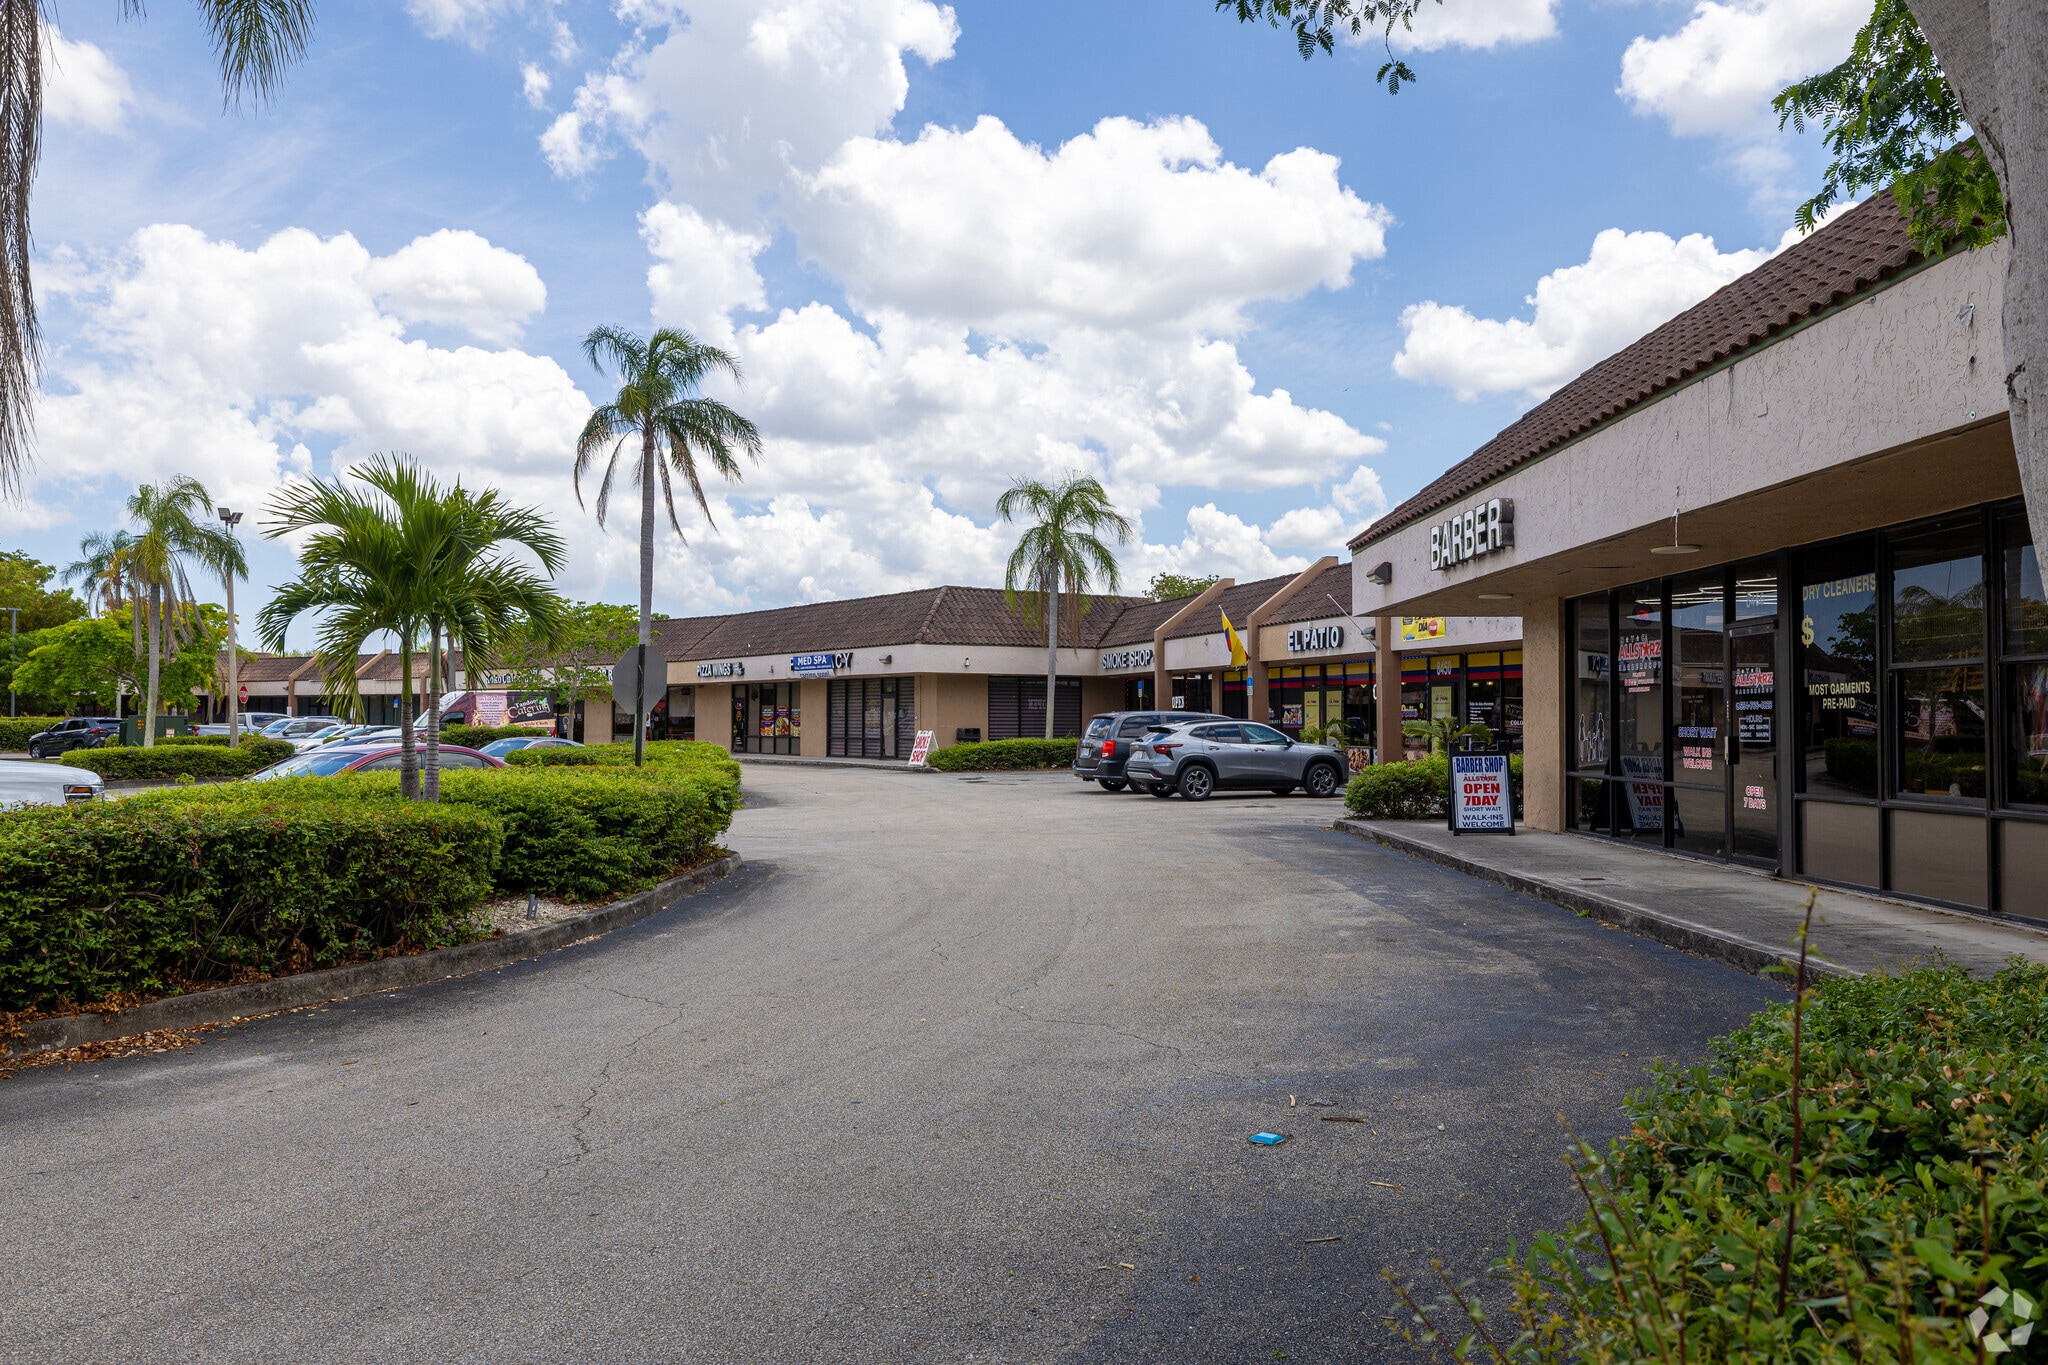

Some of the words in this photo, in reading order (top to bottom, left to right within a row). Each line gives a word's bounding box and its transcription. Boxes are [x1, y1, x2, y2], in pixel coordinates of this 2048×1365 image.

[1430, 498, 1504, 571] BARBER
[1802, 585, 1820, 601] DRY
[1823, 573, 1877, 598] CLEANERS
[1801, 614, 1815, 648] $
[1287, 631, 1301, 652] EL
[1303, 626, 1340, 650] PATIO
[797, 656, 812, 666] MED
[813, 655, 828, 665] SPA
[1102, 652, 1127, 670] SMOKE
[1130, 650, 1151, 667] SHOP
[696, 664, 712, 677] PIZZA
[1436, 660, 1452, 676] 8450
[1808, 683, 1828, 696] MOST
[1830, 680, 1871, 695] GARMENTS
[1171, 696, 1185, 709] OPEN
[1822, 697, 1856, 710] PRE-PAID
[507, 702, 551, 719] Catering
[1678, 726, 1699, 738] SHORT
[1700, 727, 1718, 739] WAIT
[1683, 746, 1701, 757] WALK
[1702, 747, 1712, 758] INS
[1456, 757, 1483, 773] BARBER
[1484, 756, 1504, 773] SHOP
[1682, 758, 1713, 770] WELCOME
[1463, 783, 1501, 794] OPEN
[1745, 785, 1764, 797] OPEN
[1463, 795, 1499, 806] 7DAY
[1749, 798, 1767, 810] DAYS
